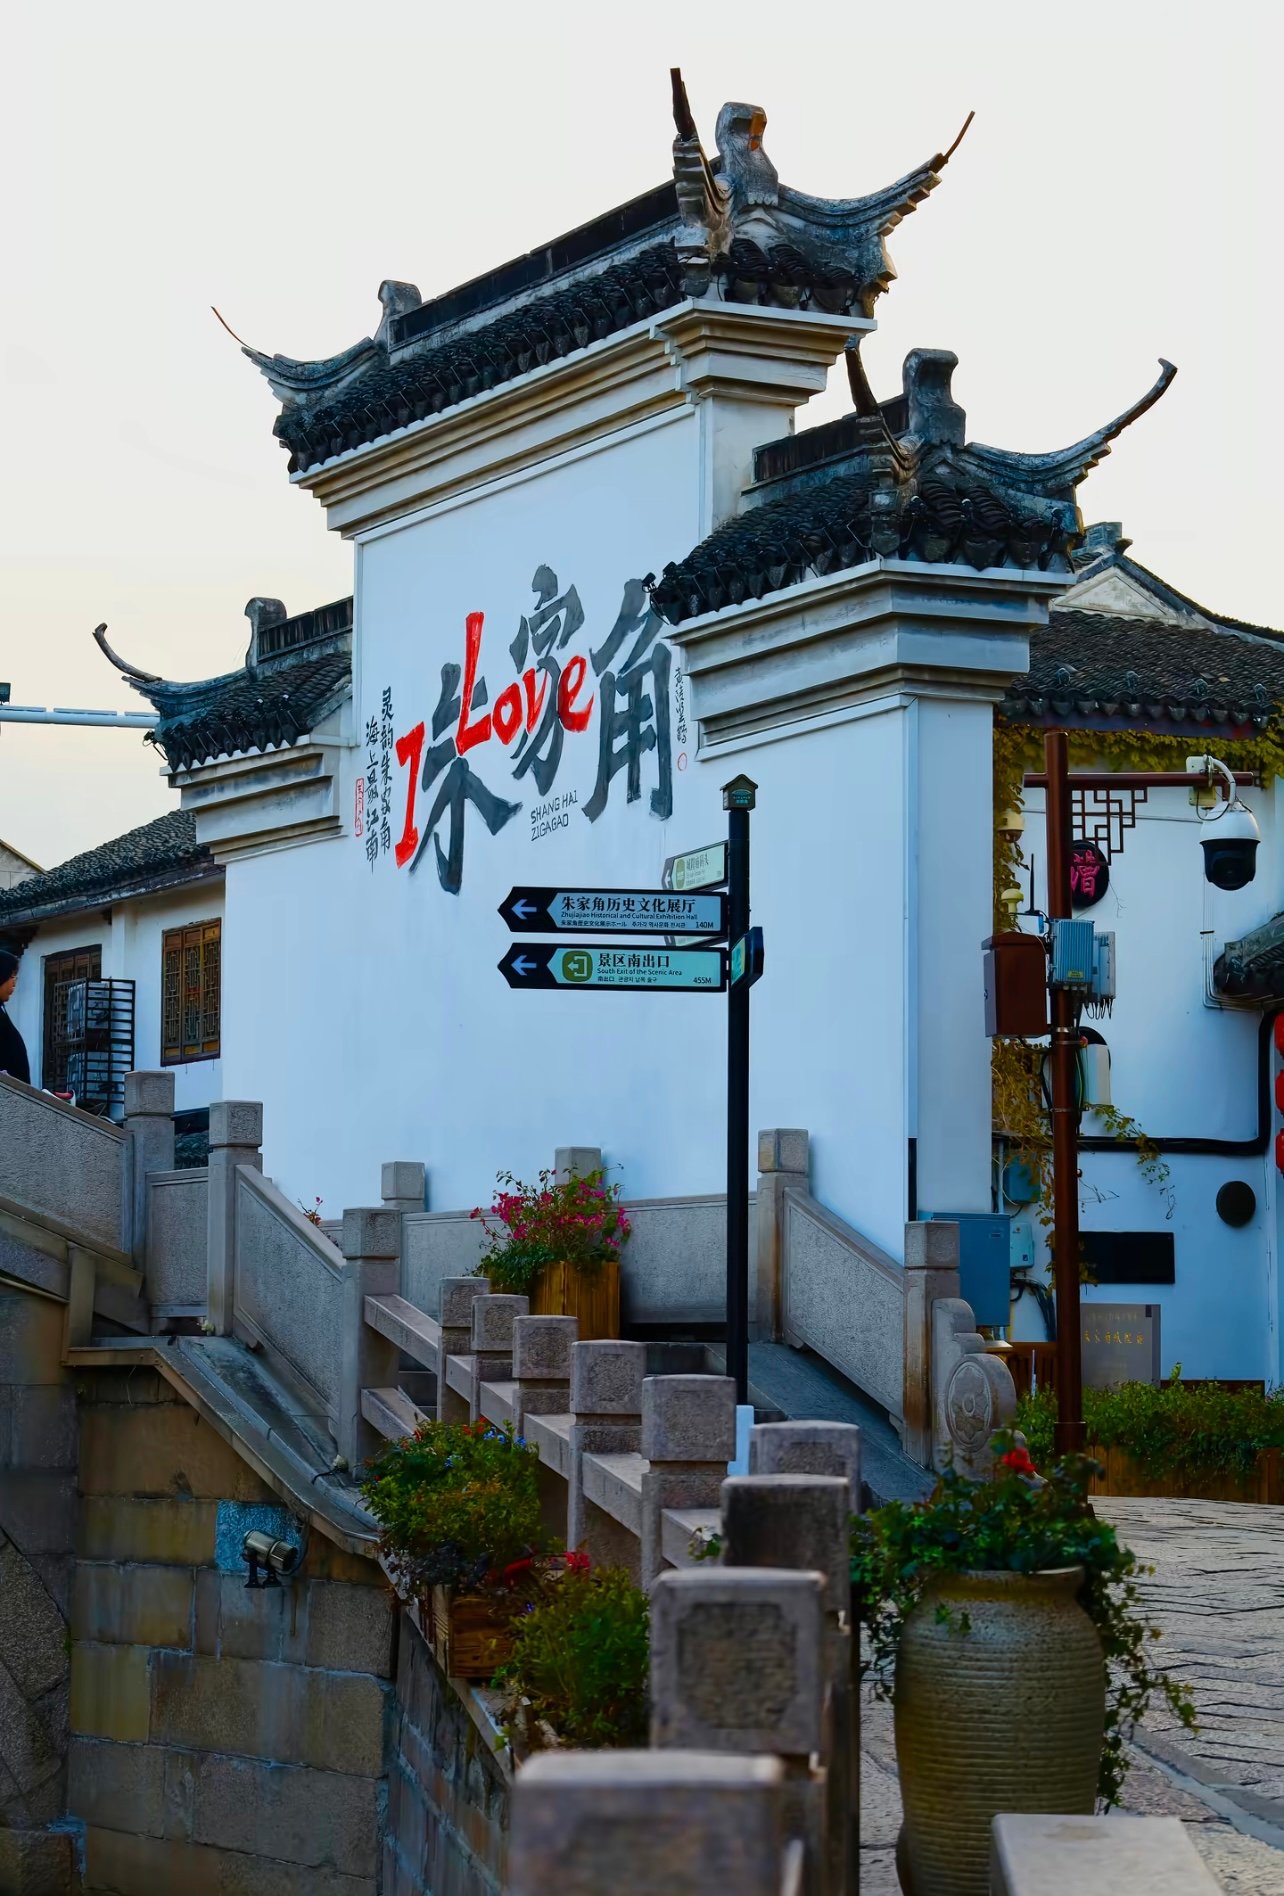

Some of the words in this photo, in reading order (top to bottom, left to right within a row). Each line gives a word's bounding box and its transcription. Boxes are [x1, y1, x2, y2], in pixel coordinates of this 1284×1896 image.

[455, 611, 595, 757] Love
[380, 686, 394, 856] 灵韵朱家角
[365, 715, 380, 875] 海上最江南
[530, 797, 560, 824] SHANG
[562, 790, 578, 808] HAI
[561, 896, 696, 913] 朱家角历史文化展厅
[561, 911, 590, 919] Zhujiajiao
[598, 953, 670, 968] 景区南出口
